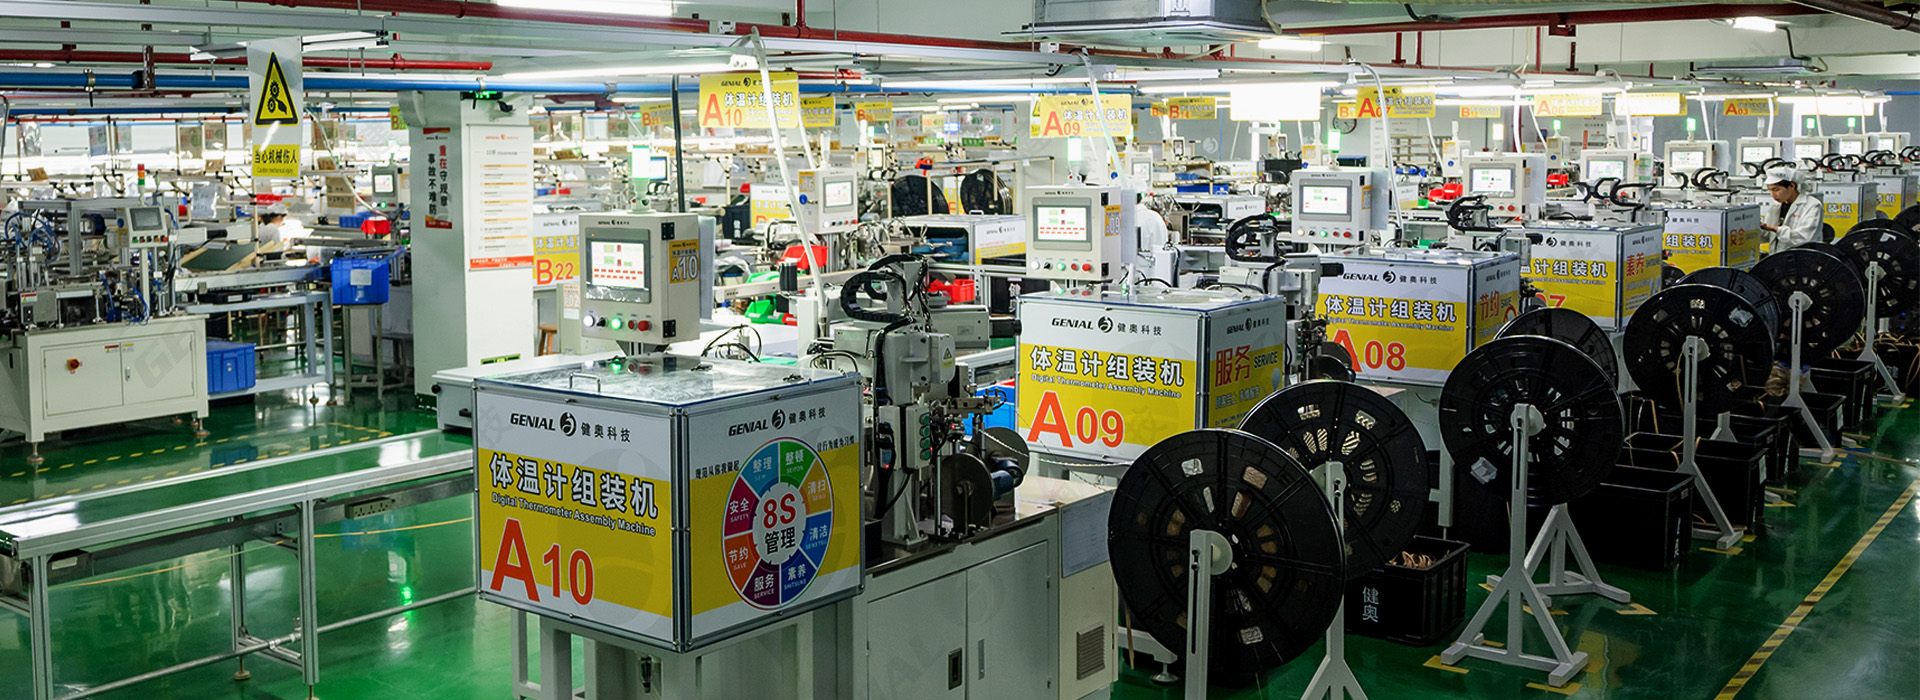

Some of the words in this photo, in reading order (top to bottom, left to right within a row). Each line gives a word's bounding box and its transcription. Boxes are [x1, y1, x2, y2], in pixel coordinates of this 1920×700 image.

[703, 94, 742, 126] A10
[1043, 111, 1080, 136] A09
[255, 149, 297, 164] 当心机械伤人
[535, 236, 579, 249] 体温计组
[536, 258, 574, 285] B22
[671, 255, 698, 281] A10
[1343, 272, 1379, 282] GENIAL
[1399, 275, 1438, 284] 健奥科技
[1325, 294, 1457, 323] 体温计组装机
[1479, 290, 1500, 321] 节约
[1051, 317, 1094, 330] GENIAL
[1117, 322, 1162, 336] 健奥科技
[1254, 350, 1278, 368] SERVICE
[1331, 329, 1406, 372] A08
[1030, 345, 1184, 387] 体温计组装机
[1215, 344, 1250, 387] 服务
[1031, 373, 1055, 384] Digital
[1057, 376, 1107, 390] Thermometer
[1107, 382, 1146, 396] Assembly
[1147, 387, 1182, 399] Machine
[510, 412, 556, 432] GENIAL
[788, 406, 826, 425] 健奥科技
[1026, 390, 1125, 449] A09
[580, 421, 631, 443] 健奥科技
[728, 418, 769, 437] GENIAL
[752, 456, 772, 473] 整理
[785, 449, 805, 466] 整顿
[489, 452, 658, 518] 体温计组装机
[807, 479, 826, 495] 清扫
[492, 492, 517, 508] Digital
[519, 498, 573, 519] Thermometer
[573, 509, 616, 531] Assembly
[617, 517, 657, 537] Machine
[729, 498, 750, 515] 安全
[763, 492, 796, 529] 8S
[730, 513, 749, 523] SAFETY
[764, 526, 796, 555] 管理
[809, 525, 828, 541] 清洁
[489, 516, 595, 606] A10
[728, 547, 749, 564] 节约
[787, 564, 806, 581] 素养
[754, 574, 775, 592] 服务
[753, 588, 775, 599] SERVICE
[1362, 586, 1379, 622] 健奥
